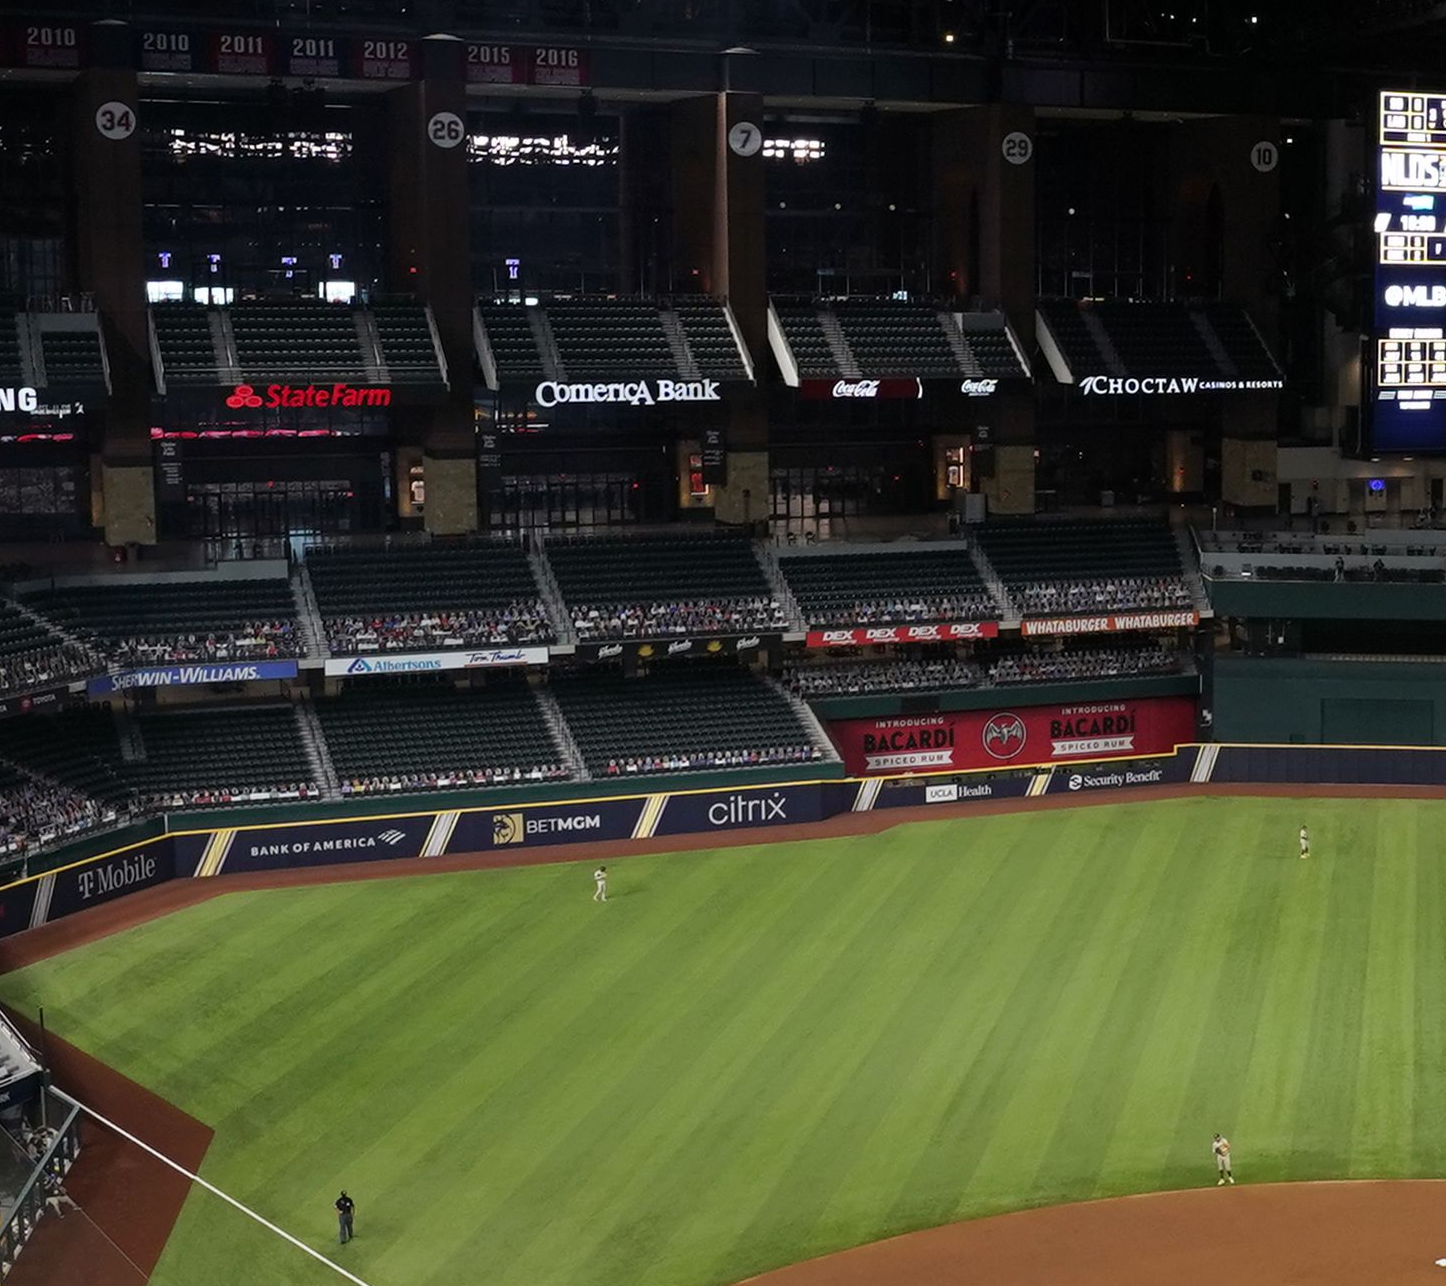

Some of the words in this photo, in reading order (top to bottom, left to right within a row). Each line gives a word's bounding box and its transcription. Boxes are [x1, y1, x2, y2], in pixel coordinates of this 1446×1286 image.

[27, 27, 76, 47] 2010
[143, 33, 189, 52] 2010
[220, 35, 263, 54] 2011
[293, 38, 334, 57] 2011
[364, 42, 407, 60] 2012
[468, 47, 510, 65] 2015
[536, 49, 578, 67] 2016
[101, 111, 131, 131] 34
[432, 120, 459, 140] 26
[738, 130, 752, 150] 7
[1006, 138, 1029, 158] 29
[1255, 146, 1274, 167] 10
[656, 379, 721, 402] Bank
[1092, 375, 1199, 395] CHOCTAW
[1246, 380, 1283, 389] RESORTS
[1026, 617, 1109, 635] WHATABURGER
[1114, 612, 1195, 632] WHATABURGER
[374, 658, 442, 672] Albertsons
[465, 652, 488, 663] Tom
[488, 648, 526, 661] Thumb
[33, 694, 56, 705] TOYOTA
[1061, 704, 1126, 716] INTRODUCING
[875, 717, 945, 729] INTRODUCING
[1061, 742, 1100, 753] SPICED
[1104, 739, 1126, 751] RUM
[875, 755, 915, 767] SPICED
[919, 753, 945, 764] RUM
[1082, 773, 1123, 789] Security
[1125, 769, 1162, 784] Benefit
[931, 789, 953, 800] UCLA
[958, 784, 992, 798] Health
[708, 792, 786, 825] citrix
[526, 815, 600, 834] BETMGM
[251, 844, 290, 857] BANK
[293, 842, 310, 854] OF
[312, 837, 376, 853] AMERICA
